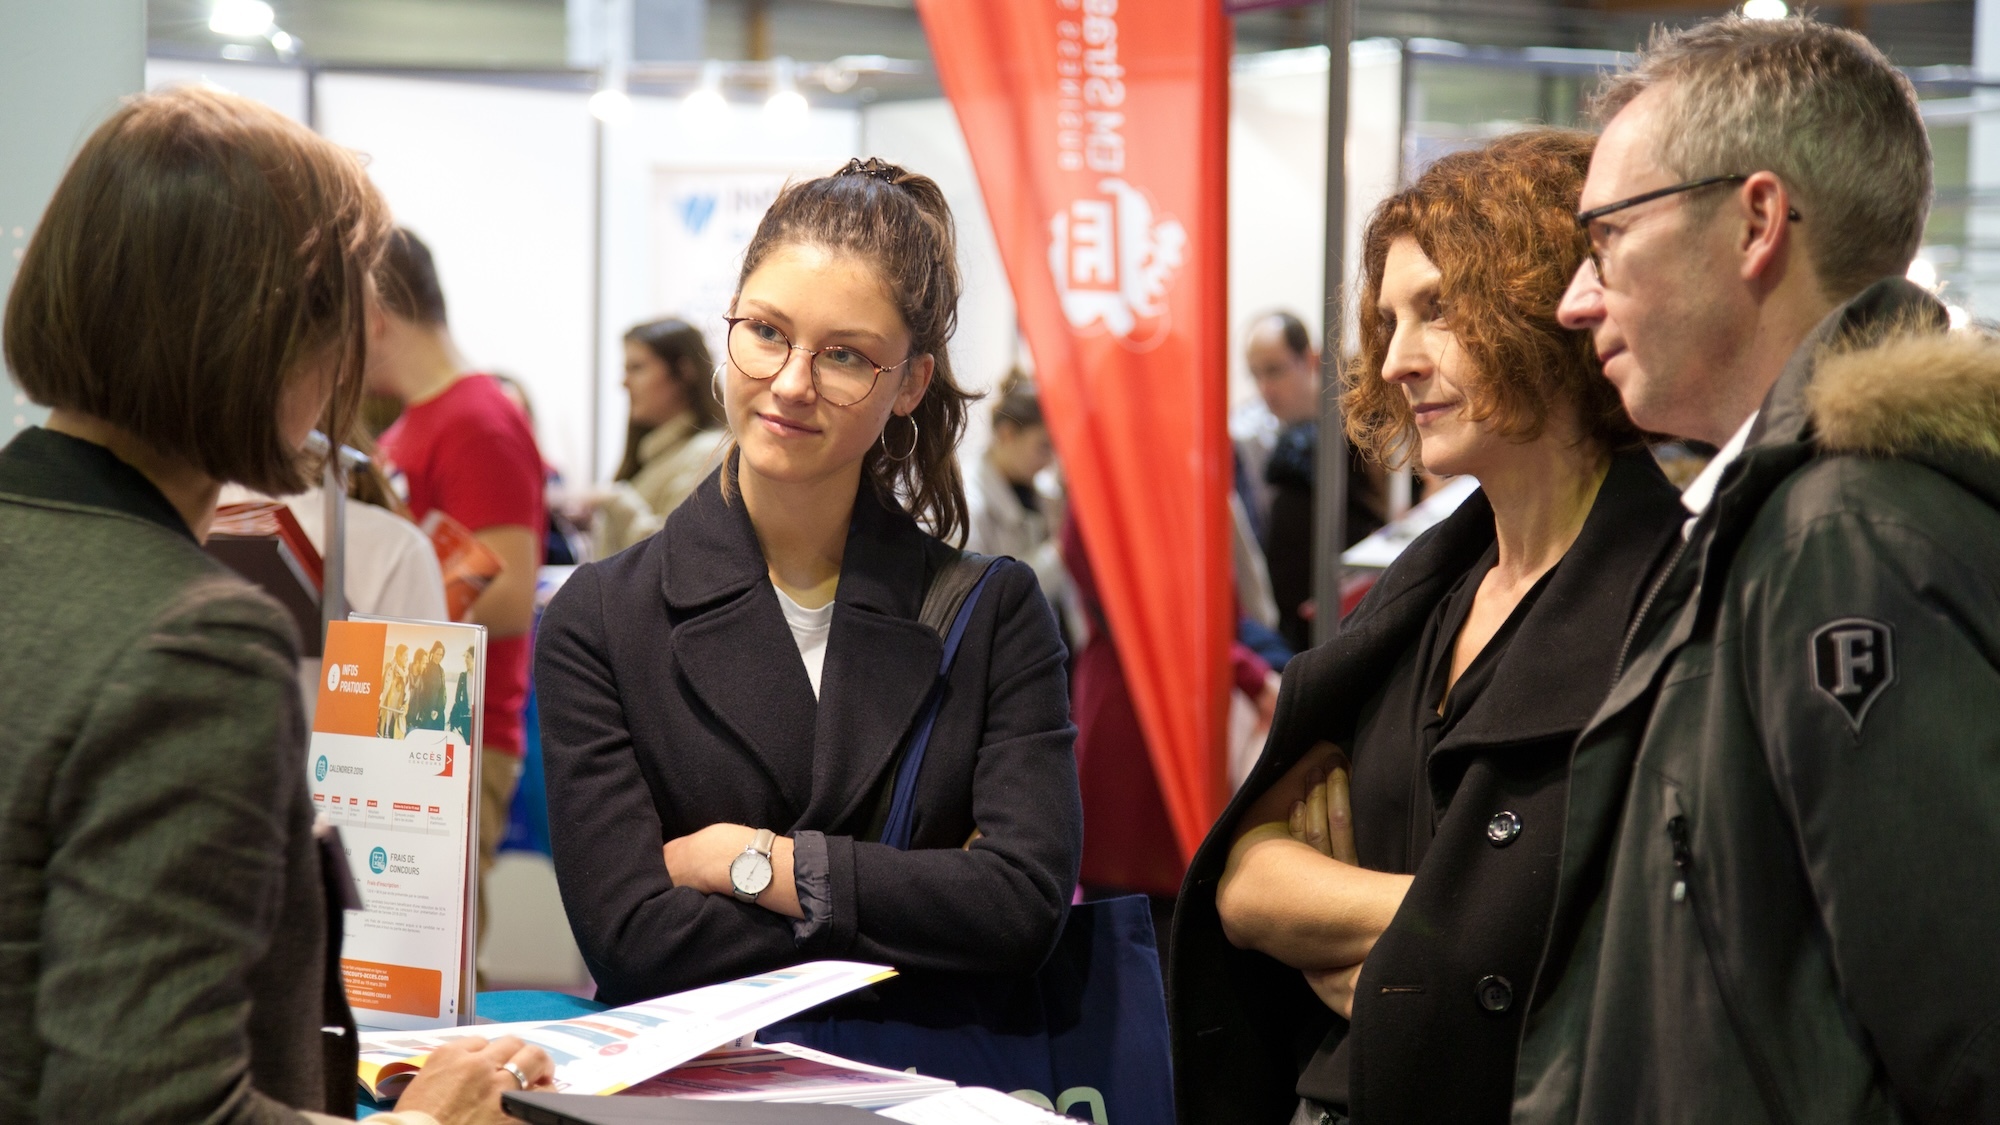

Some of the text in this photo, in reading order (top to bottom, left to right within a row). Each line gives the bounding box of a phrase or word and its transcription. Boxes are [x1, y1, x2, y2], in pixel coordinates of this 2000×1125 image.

[1831, 629, 1874, 695] F
[342, 664, 359, 677] INFOS
[340, 681, 371, 694] PRATIQUES
[408, 751, 442, 762] ACCÈS
[329, 764, 364, 775] CALENDRIER 2019
[390, 852, 415, 863] FRAIS DE
[389, 864, 420, 876] CONCOURS
